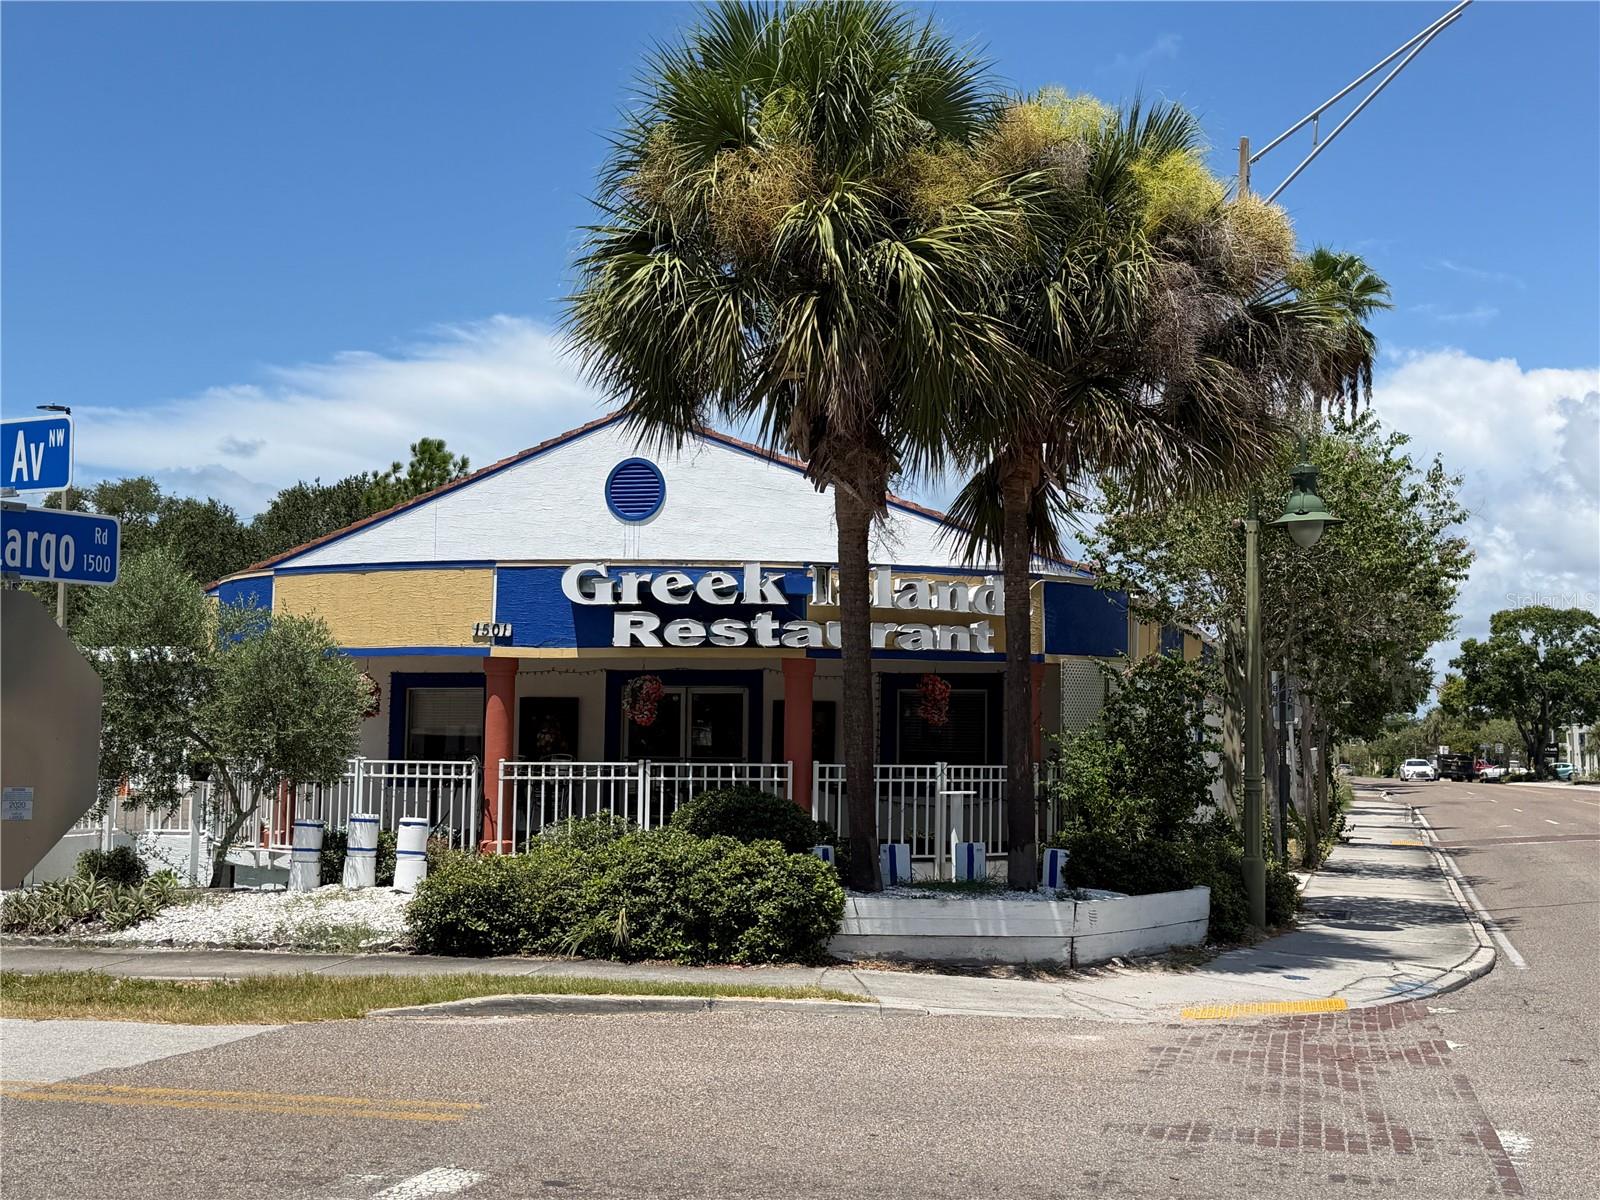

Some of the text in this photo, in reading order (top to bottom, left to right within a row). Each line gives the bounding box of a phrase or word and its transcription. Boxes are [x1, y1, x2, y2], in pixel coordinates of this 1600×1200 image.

[10, 428, 65, 483] Av NW
[0, 527, 108, 578] argo Rd
[83, 553, 111, 573] 1500
[561, 561, 1006, 616] Greek Iland
[475, 622, 507, 637] 1501
